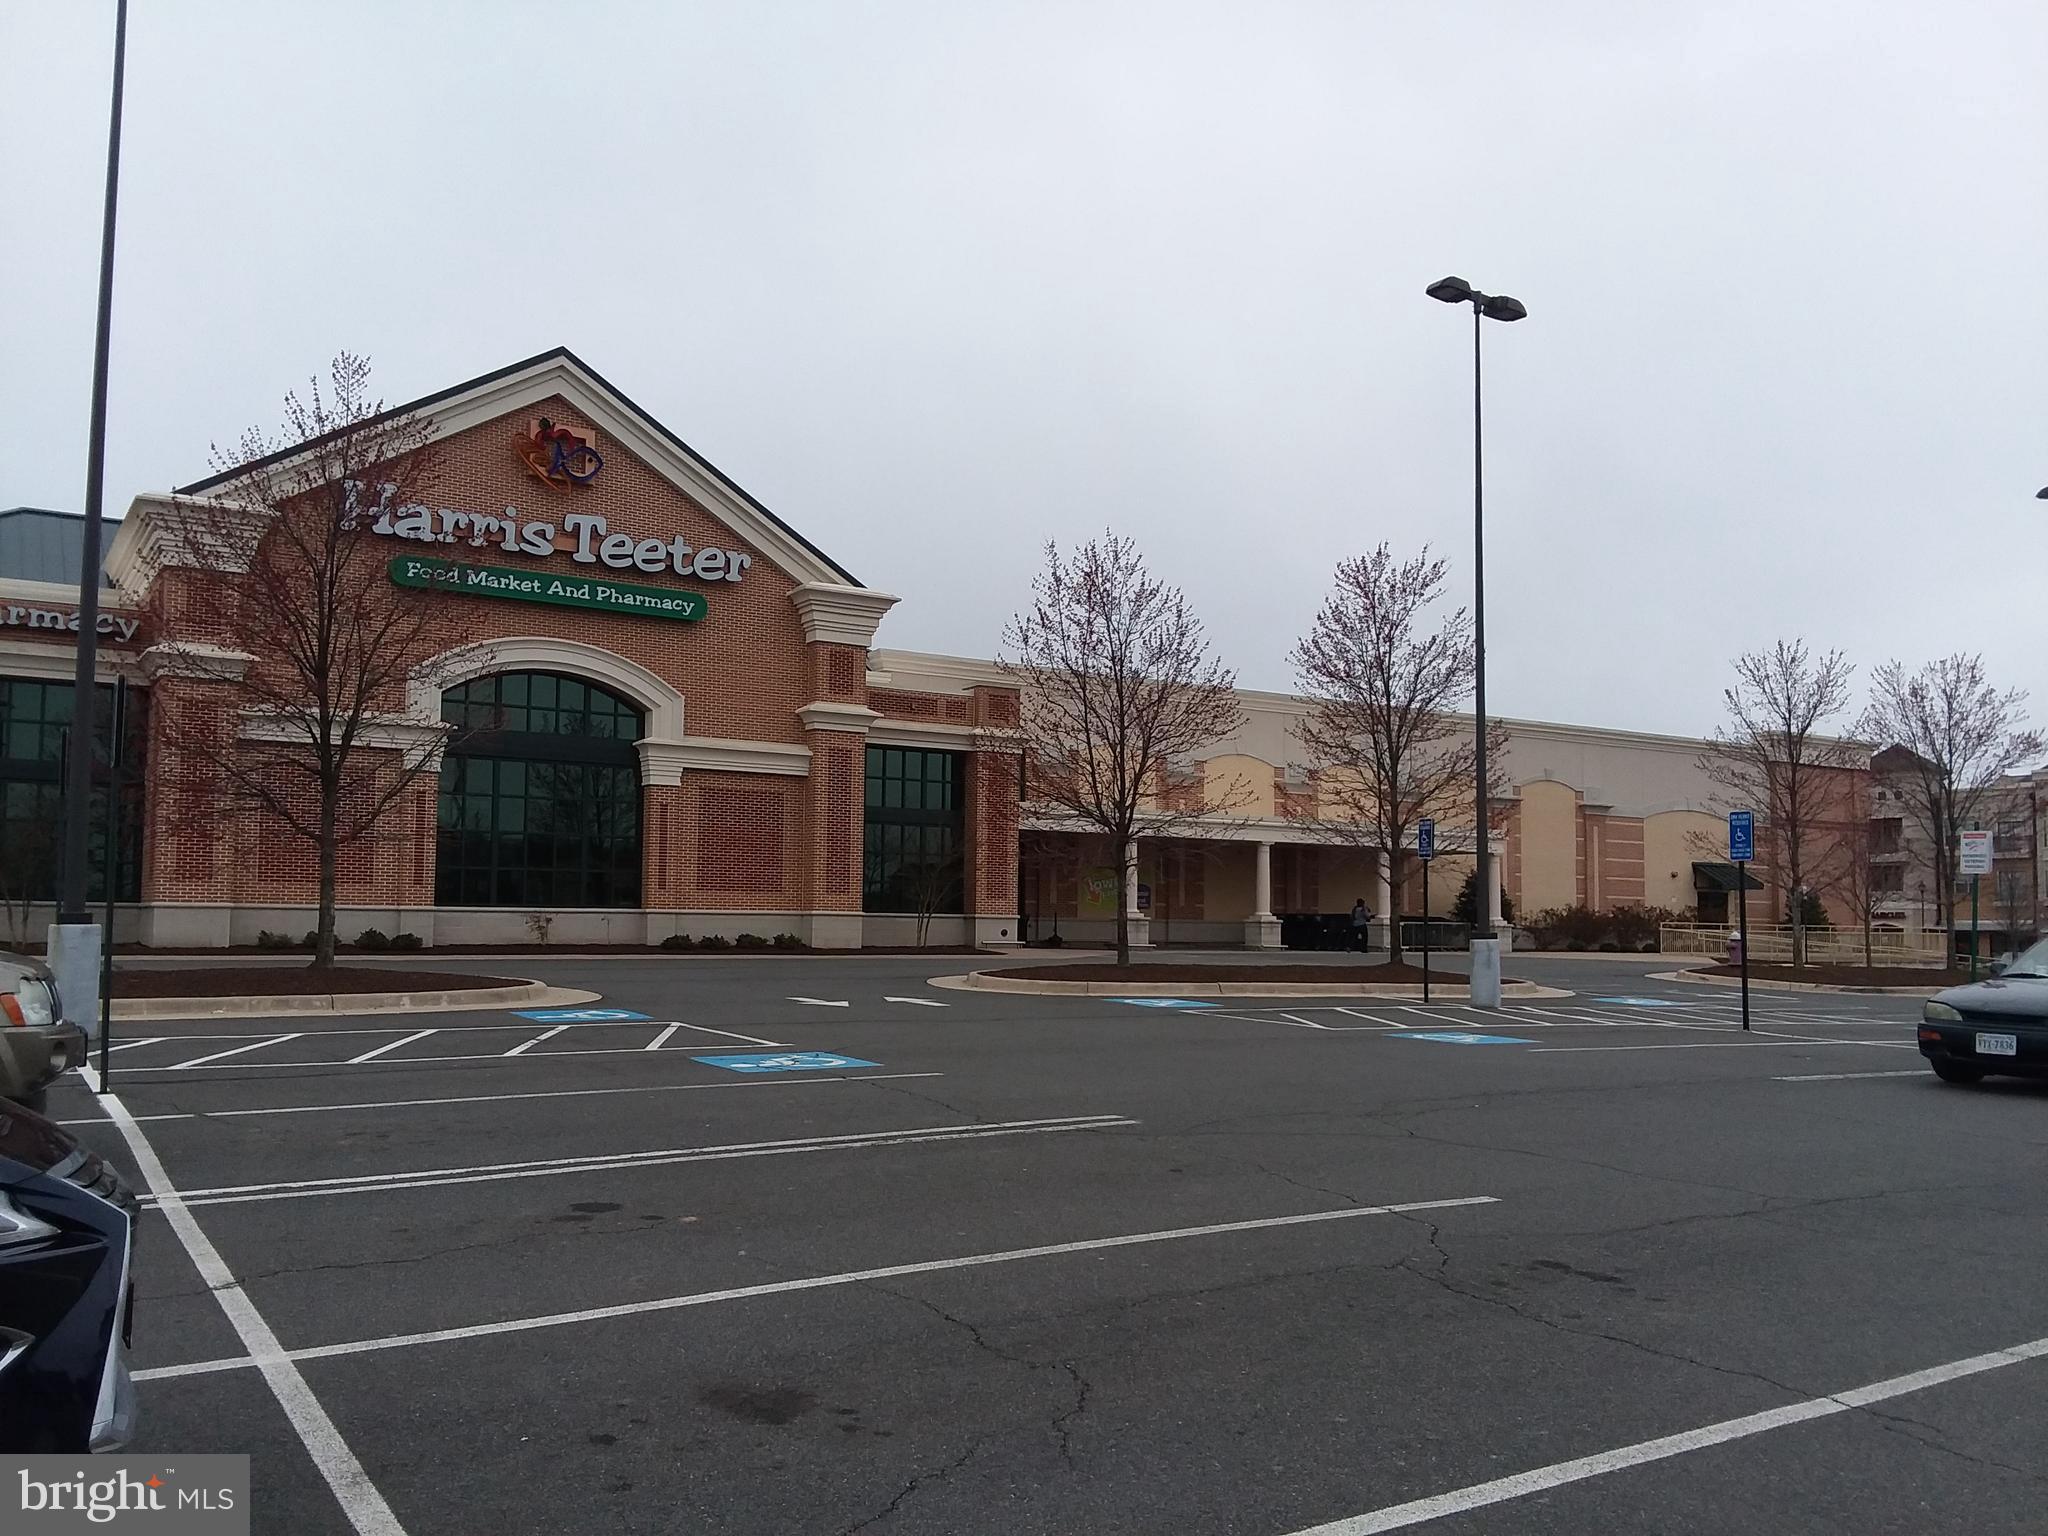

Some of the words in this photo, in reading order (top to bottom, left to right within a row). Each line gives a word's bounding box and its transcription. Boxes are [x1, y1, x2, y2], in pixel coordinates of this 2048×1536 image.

[340, 479, 555, 556] Harris
[564, 513, 751, 582] Teeter
[406, 562, 460, 584] Food
[467, 569, 541, 594] Market
[547, 580, 591, 600] And
[597, 586, 695, 616] Pharmacy
[0, 605, 139, 643] rmcy
